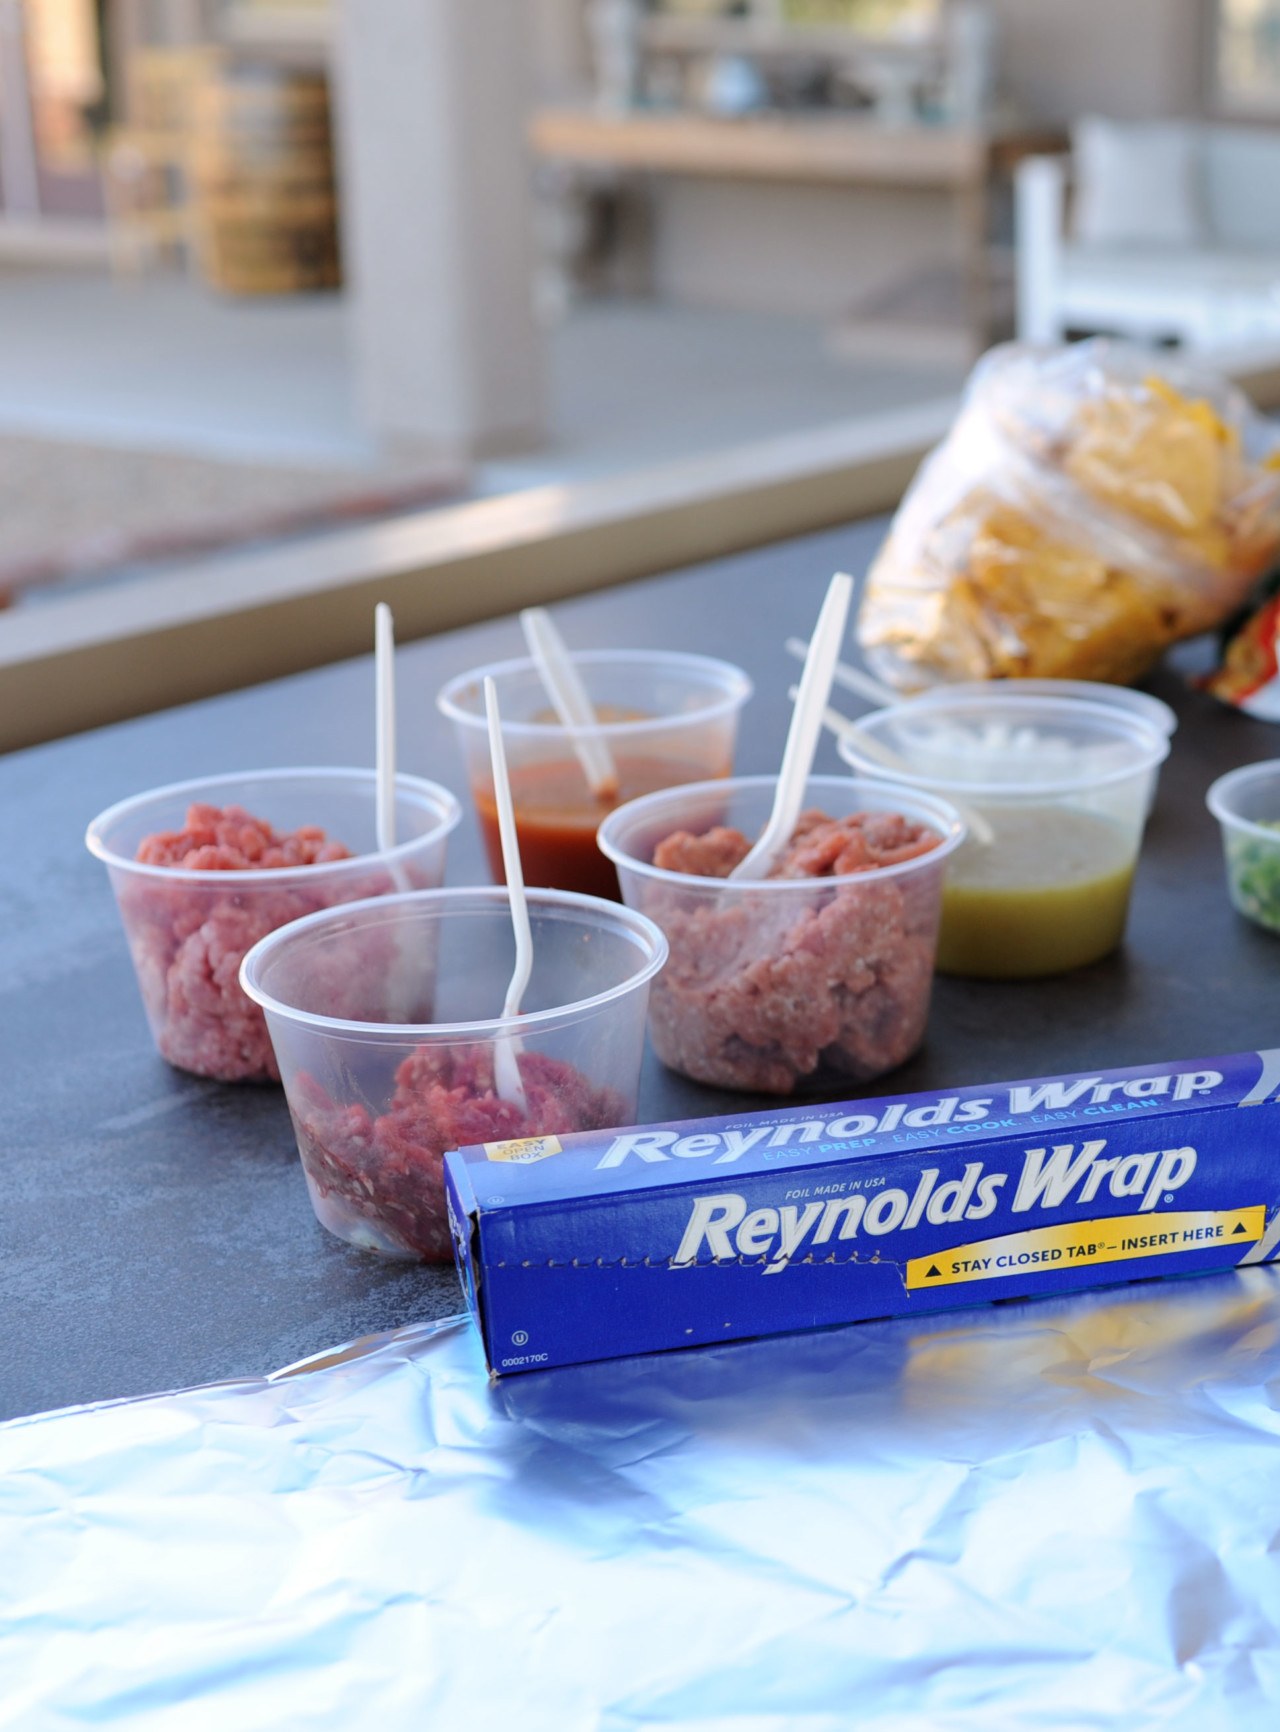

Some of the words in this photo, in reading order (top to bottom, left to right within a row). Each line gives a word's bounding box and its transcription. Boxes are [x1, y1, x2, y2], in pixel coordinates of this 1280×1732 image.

[724, 1121, 755, 1130] FOIL
[759, 1117, 796, 1126] MADE
[818, 1111, 845, 1119] USA
[496, 1138, 547, 1150] EASY
[592, 1096, 993, 1171] Reynolds
[763, 1146, 812, 1161] EASY
[892, 1129, 941, 1144] EASY
[1031, 1110, 1077, 1125] EASY
[502, 1144, 545, 1155] OPEN
[510, 1152, 543, 1161] BOX
[785, 1189, 811, 1200] FOIL
[814, 1183, 846, 1197] MADE
[849, 1180, 861, 1191] IN
[864, 1176, 886, 1188] USA
[668, 1162, 1008, 1276] Reynolds
[951, 1257, 991, 1275] STAY
[995, 1248, 1063, 1269] CLOSED
[1121, 1233, 1177, 1252] INSERT
[1182, 1225, 1225, 1243] HERE
[501, 1352, 549, 1368] 0002170C
